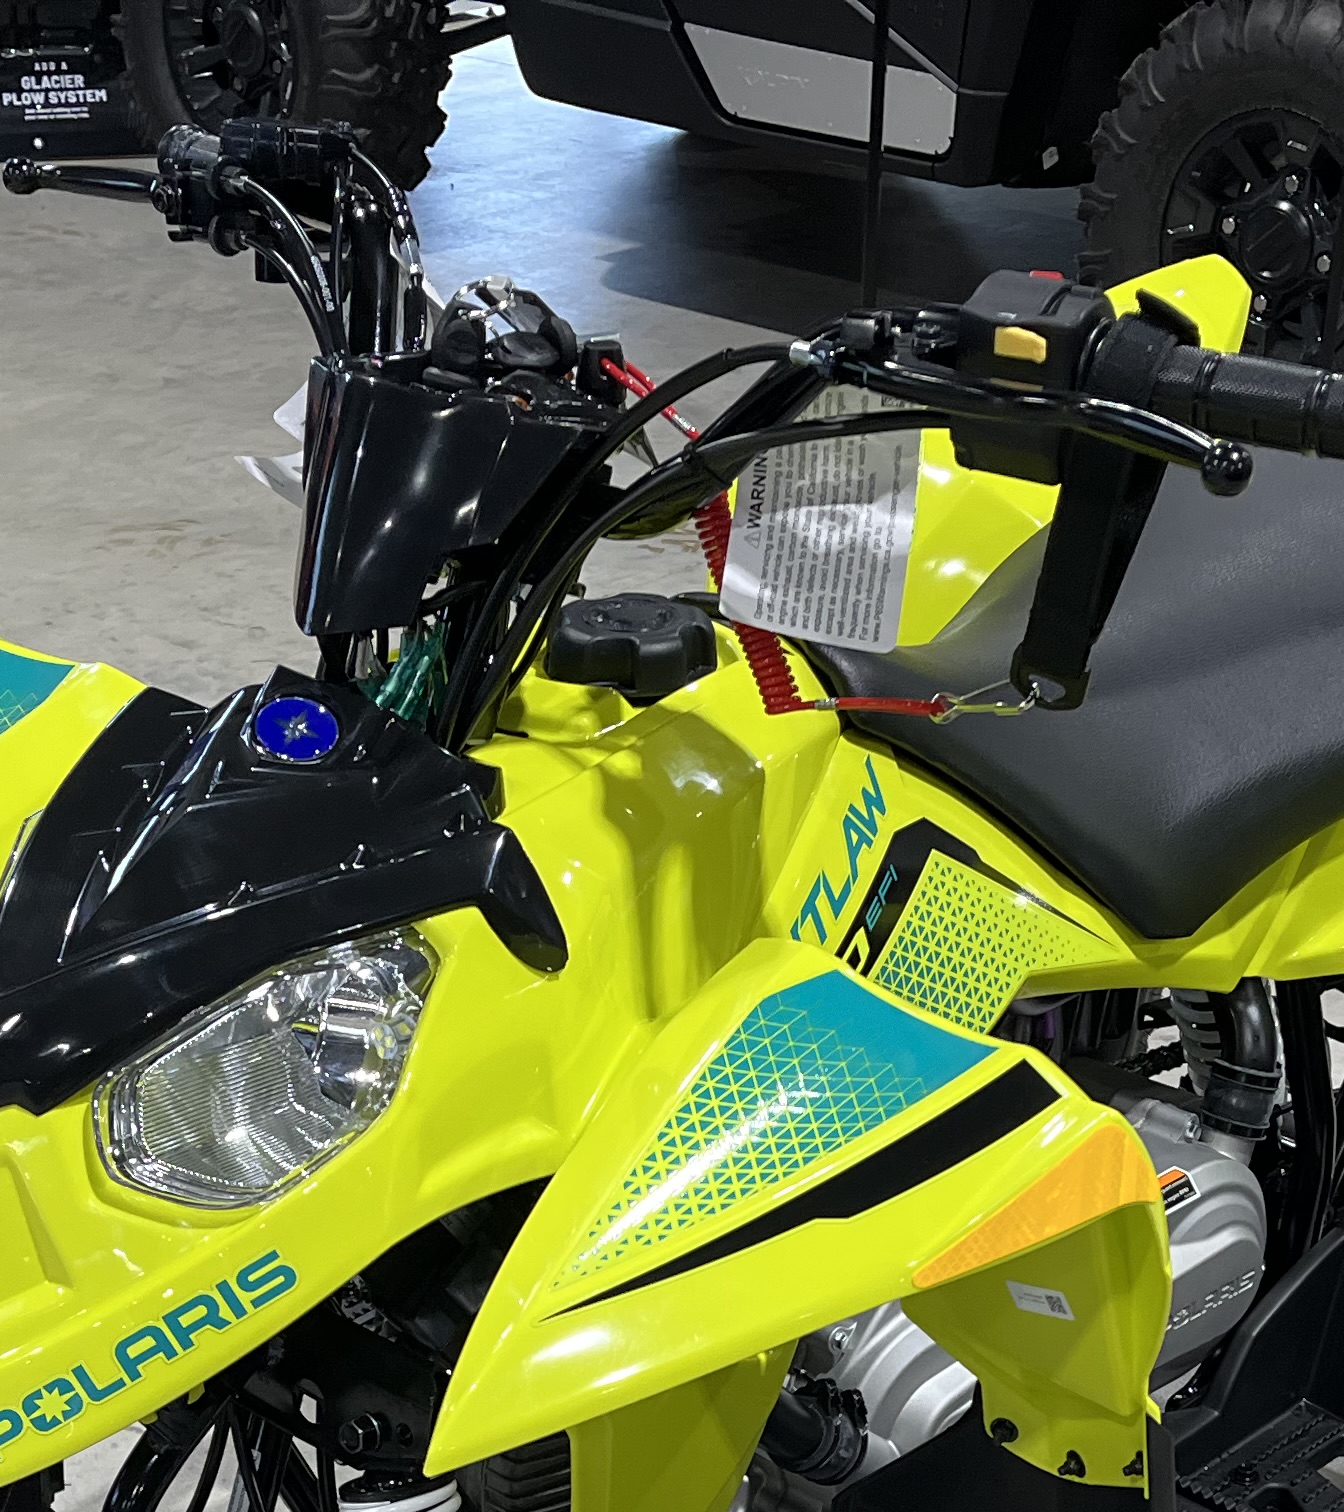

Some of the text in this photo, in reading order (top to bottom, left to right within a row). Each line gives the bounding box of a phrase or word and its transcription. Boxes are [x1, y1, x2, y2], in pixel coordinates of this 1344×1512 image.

[21, 75, 85, 89] GLACIER
[2, 89, 108, 106] PLOW SYSTEM
[832, 452, 841, 468] not
[784, 468, 793, 480] to
[805, 452, 820, 496] California
[832, 469, 841, 482] do
[745, 451, 769, 529] WARNIN
[783, 480, 793, 499] you
[779, 500, 790, 533] expose
[765, 523, 775, 542] and
[776, 534, 785, 552] can
[799, 534, 809, 550] the
[811, 526, 822, 551] other
[821, 523, 836, 567] breathing
[847, 536, 856, 554] and
[797, 550, 807, 560] to
[810, 551, 818, 561] or
[824, 607, 835, 635] except
[843, 457, 854, 487] vehicle
[857, 529, 871, 571] servicing
[772, 553, 782, 582] vehicle
[778, 599, 789, 625] engine
[787, 530, 797, 562] carbon
[793, 560, 805, 589] known
[845, 555, 854, 575] area
[805, 562, 817, 595] defects
[818, 566, 829, 591] avoid
[854, 571, 864, 596] when
[857, 525, 882, 641] For more information go to
[792, 590, 801, 604] are
[834, 576, 851, 637] well-ventilated
[766, 614, 774, 622] or
[788, 604, 799, 628] which
[801, 614, 810, 630] and
[846, 597, 862, 639] frequently
[865, 863, 898, 932] EFI
[1166, 1271, 1256, 1330] OLARIS
